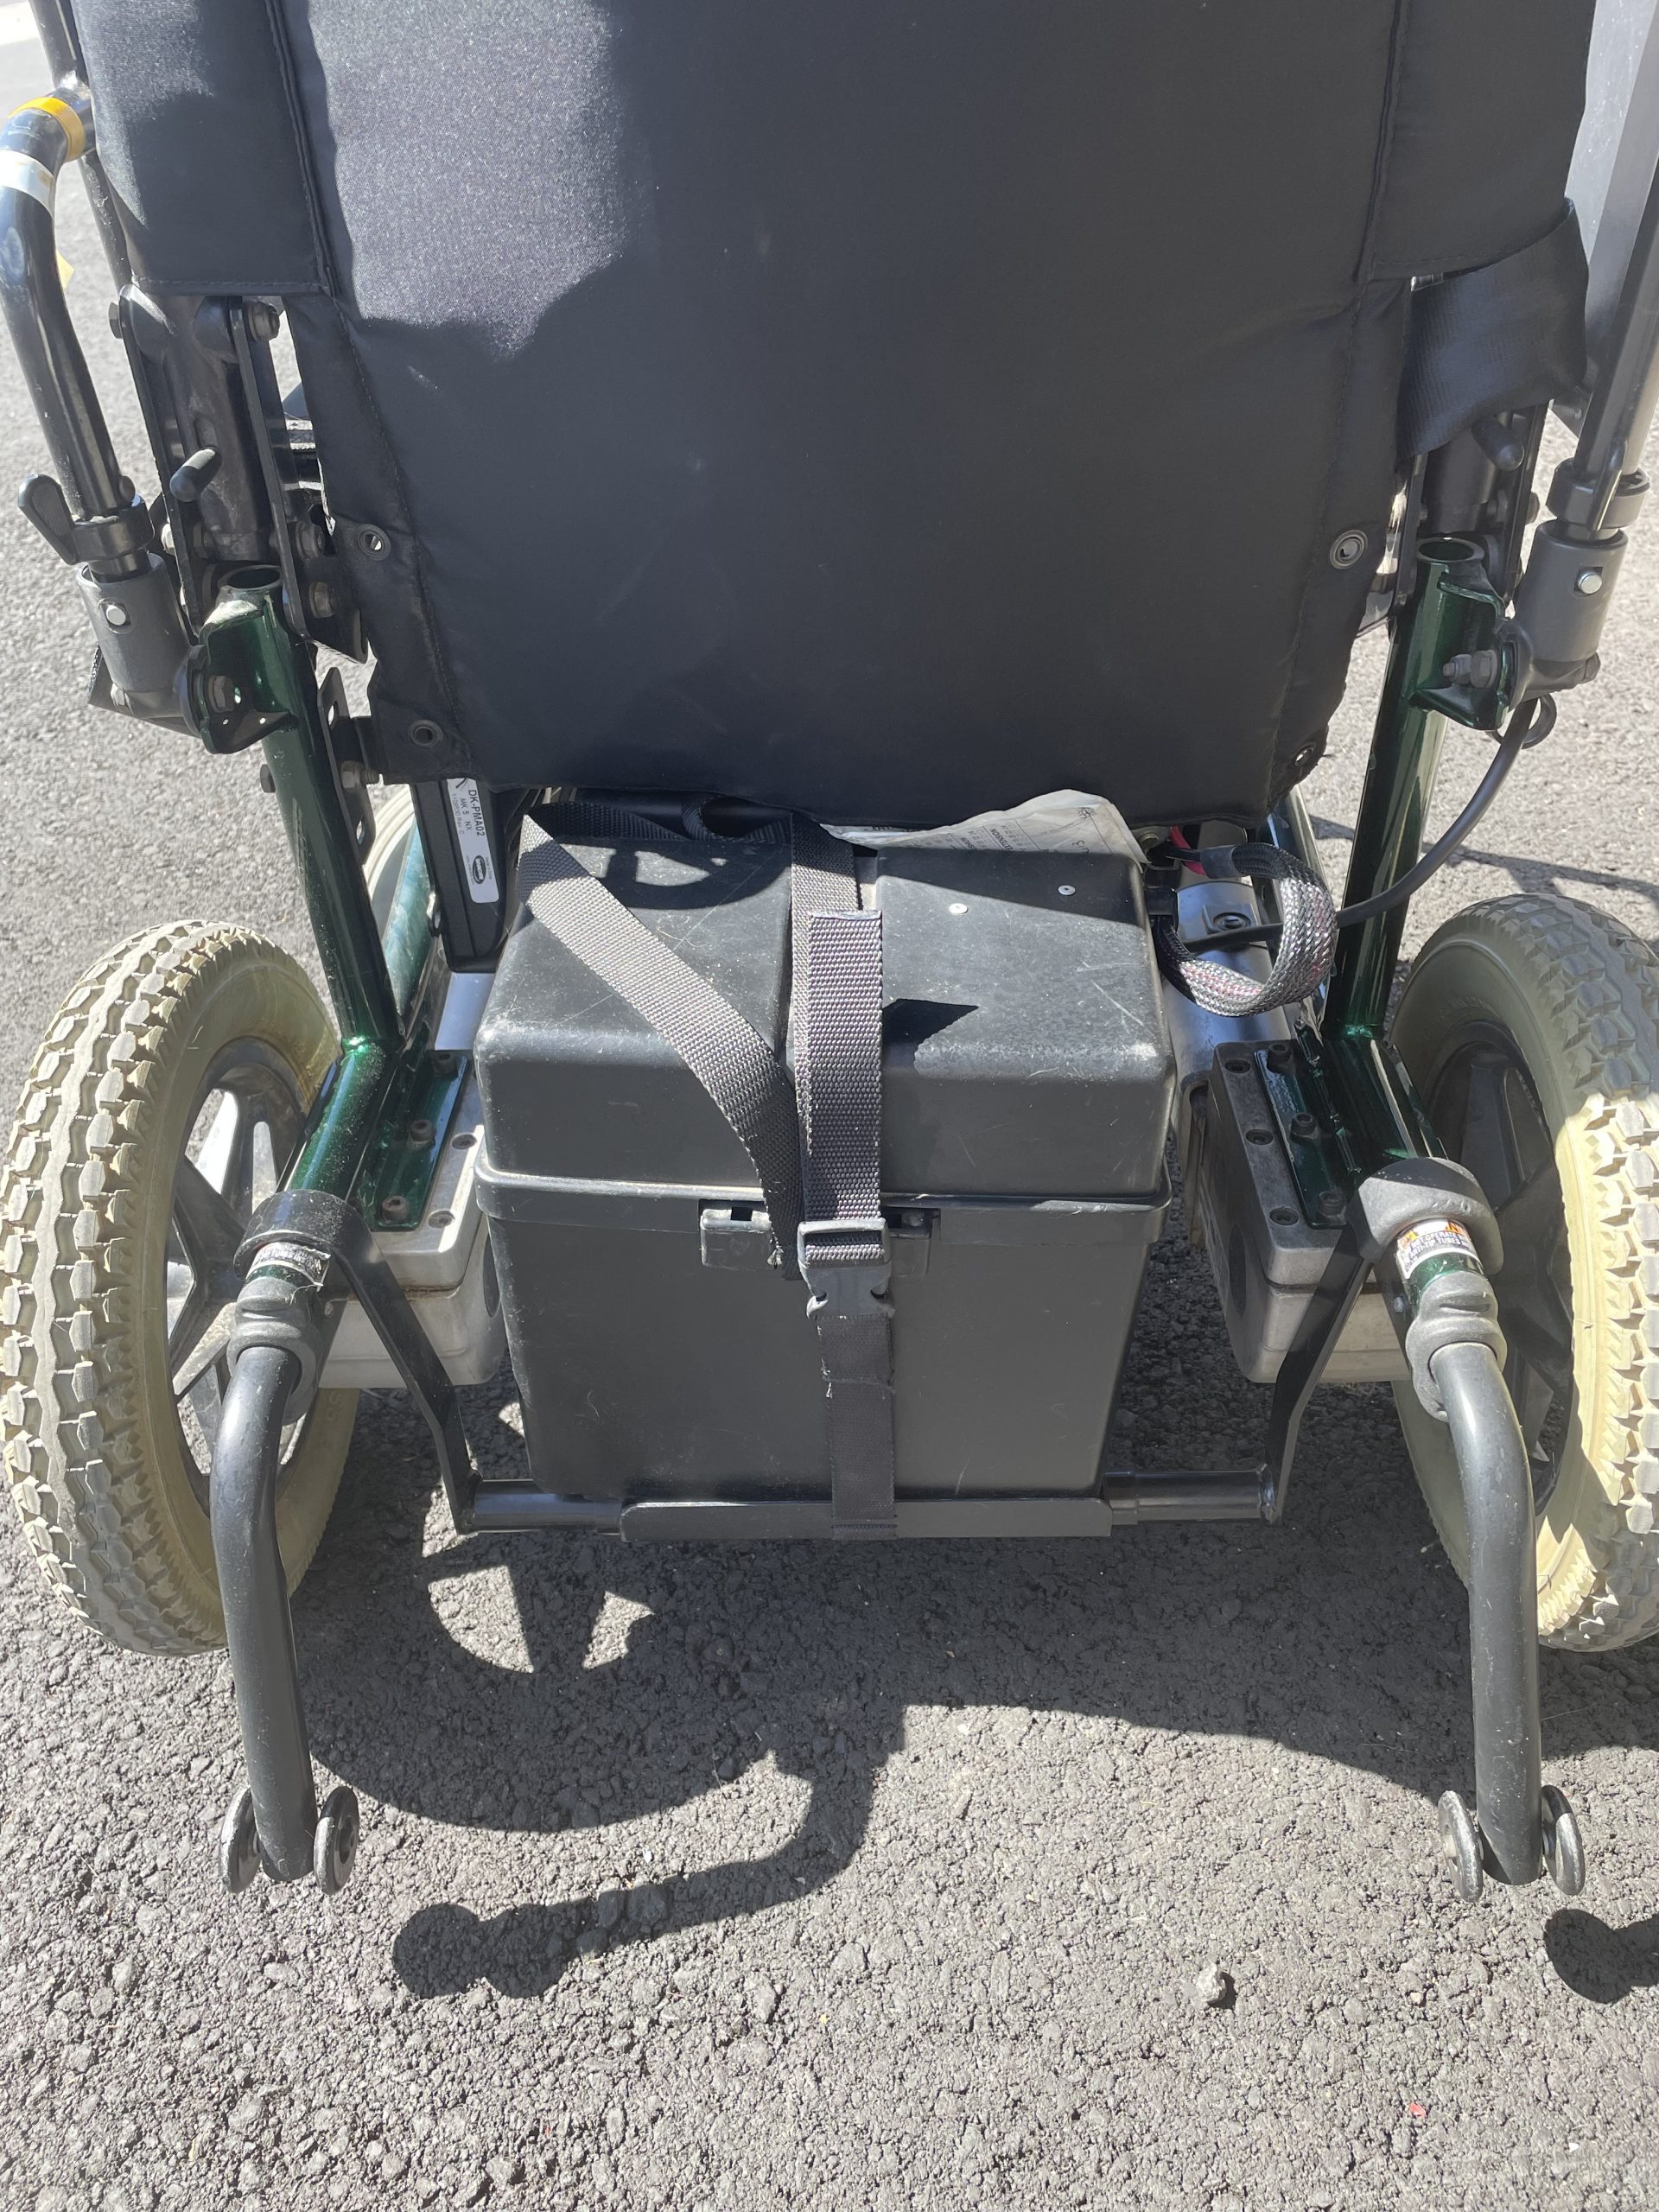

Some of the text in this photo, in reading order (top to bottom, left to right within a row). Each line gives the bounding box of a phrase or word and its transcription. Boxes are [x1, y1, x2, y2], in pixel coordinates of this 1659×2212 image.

[460, 798, 468, 809] MK
[465, 821, 473, 830] NX
[468, 789, 486, 836] DK-PMA02
